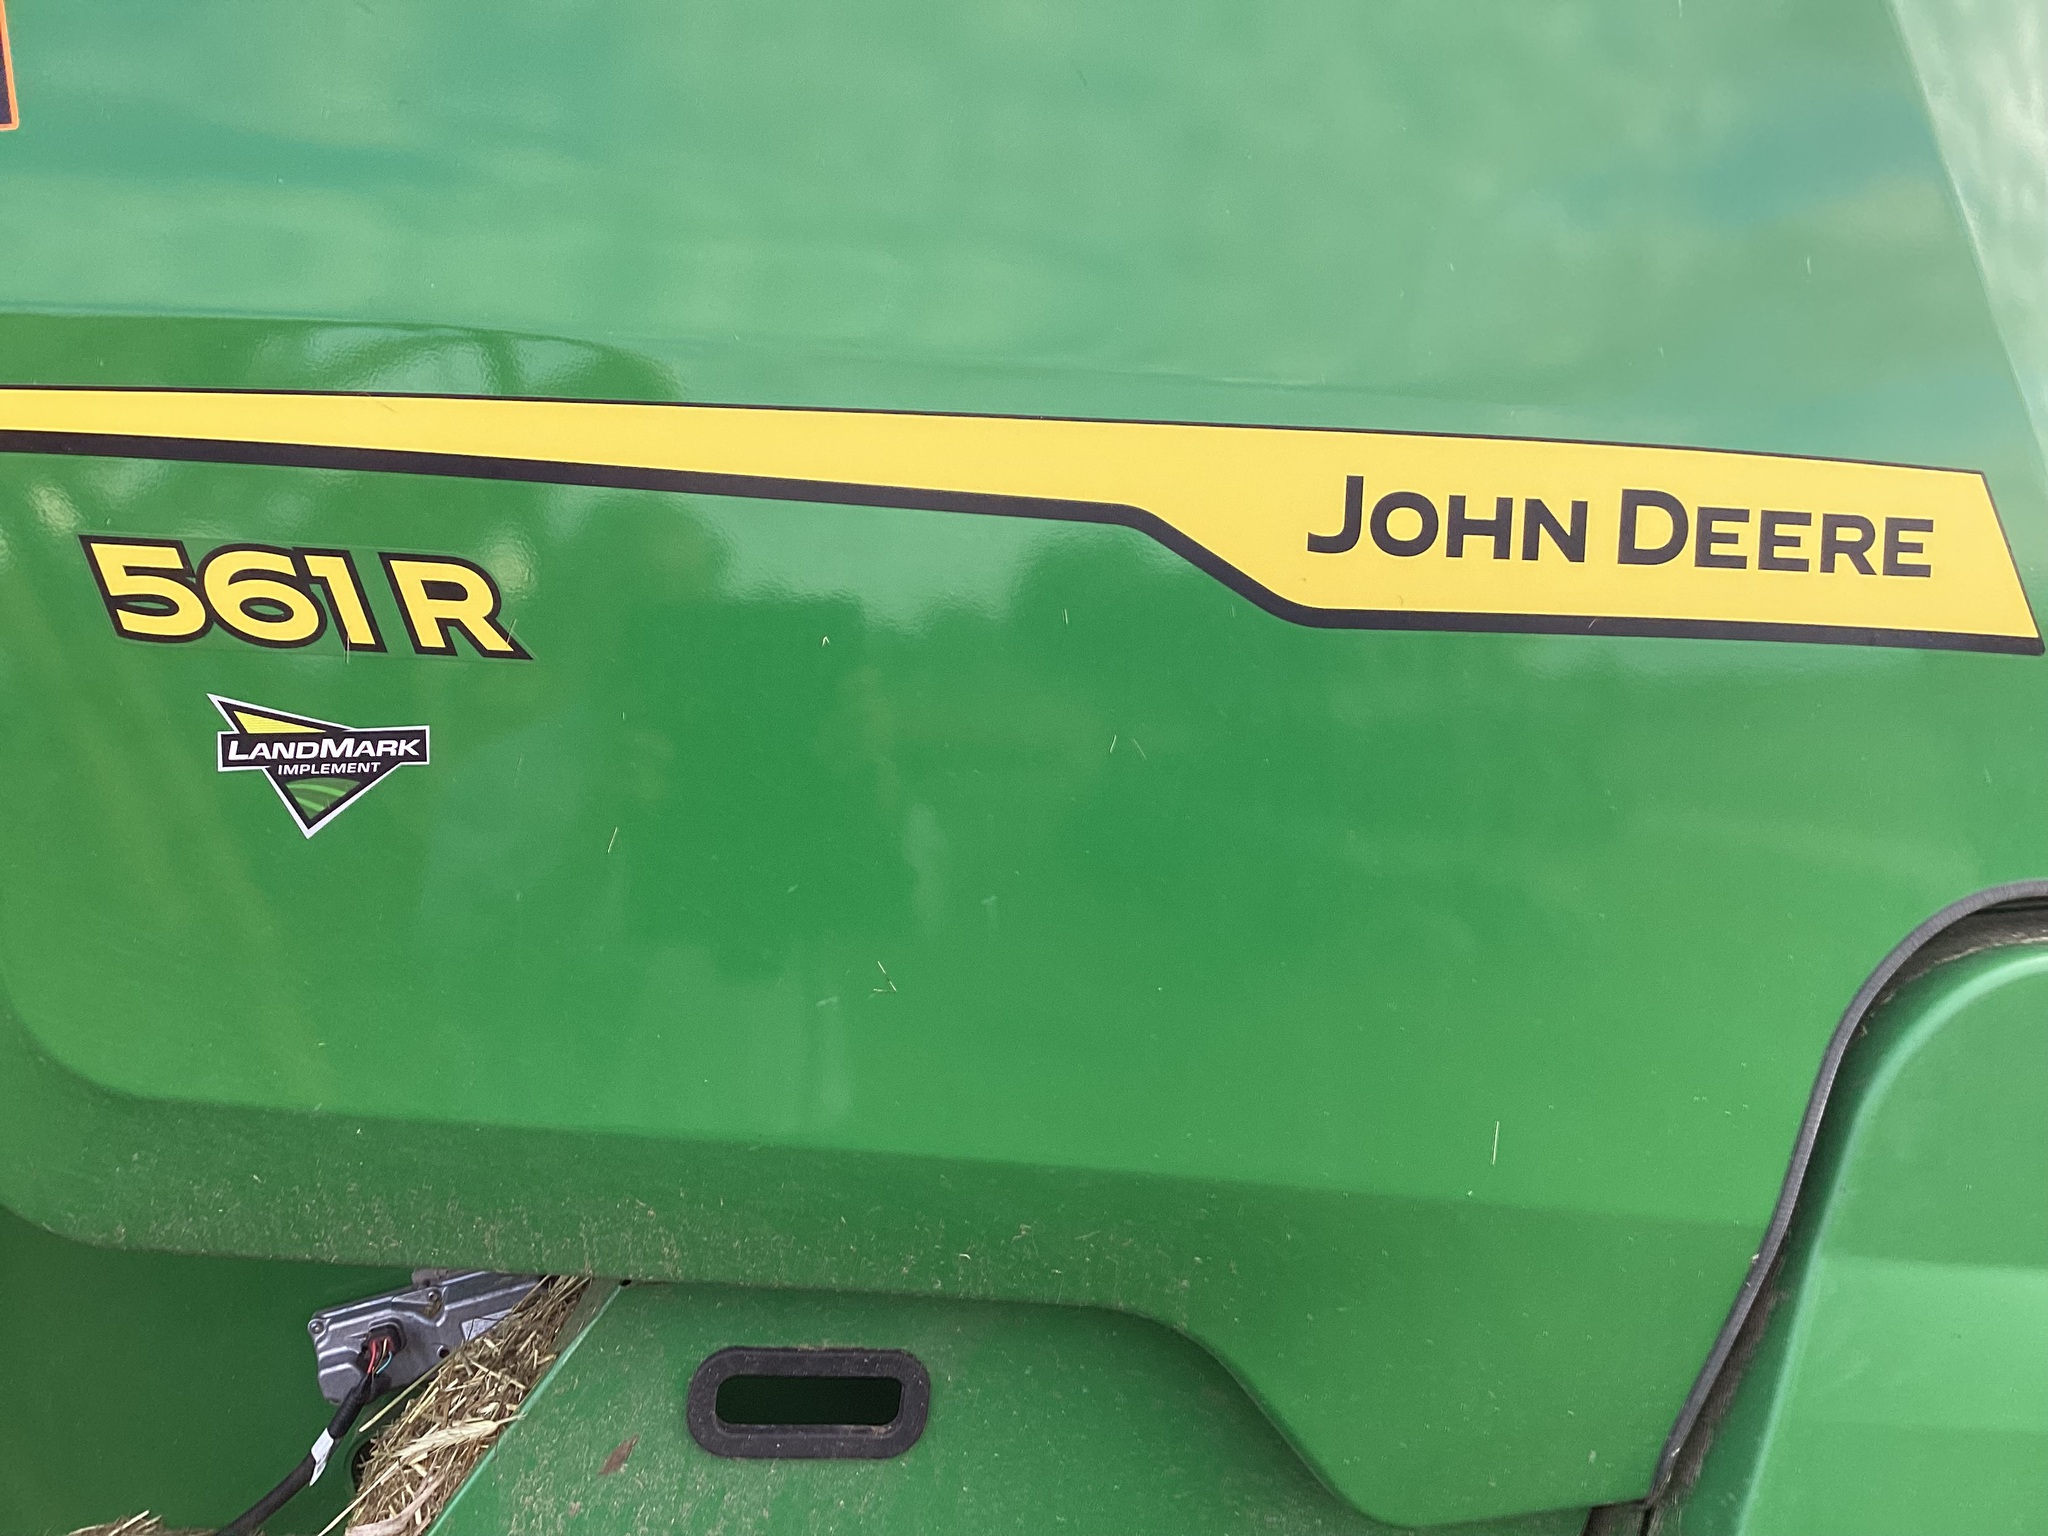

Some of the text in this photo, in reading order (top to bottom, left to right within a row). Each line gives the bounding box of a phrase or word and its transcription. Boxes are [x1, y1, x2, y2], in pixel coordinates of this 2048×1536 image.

[1307, 475, 1934, 578] JOHN DEERE
[80, 535, 532, 660] 561 R
[227, 737, 420, 760] LANDMARK
[277, 761, 381, 776] IMPLEMENT
